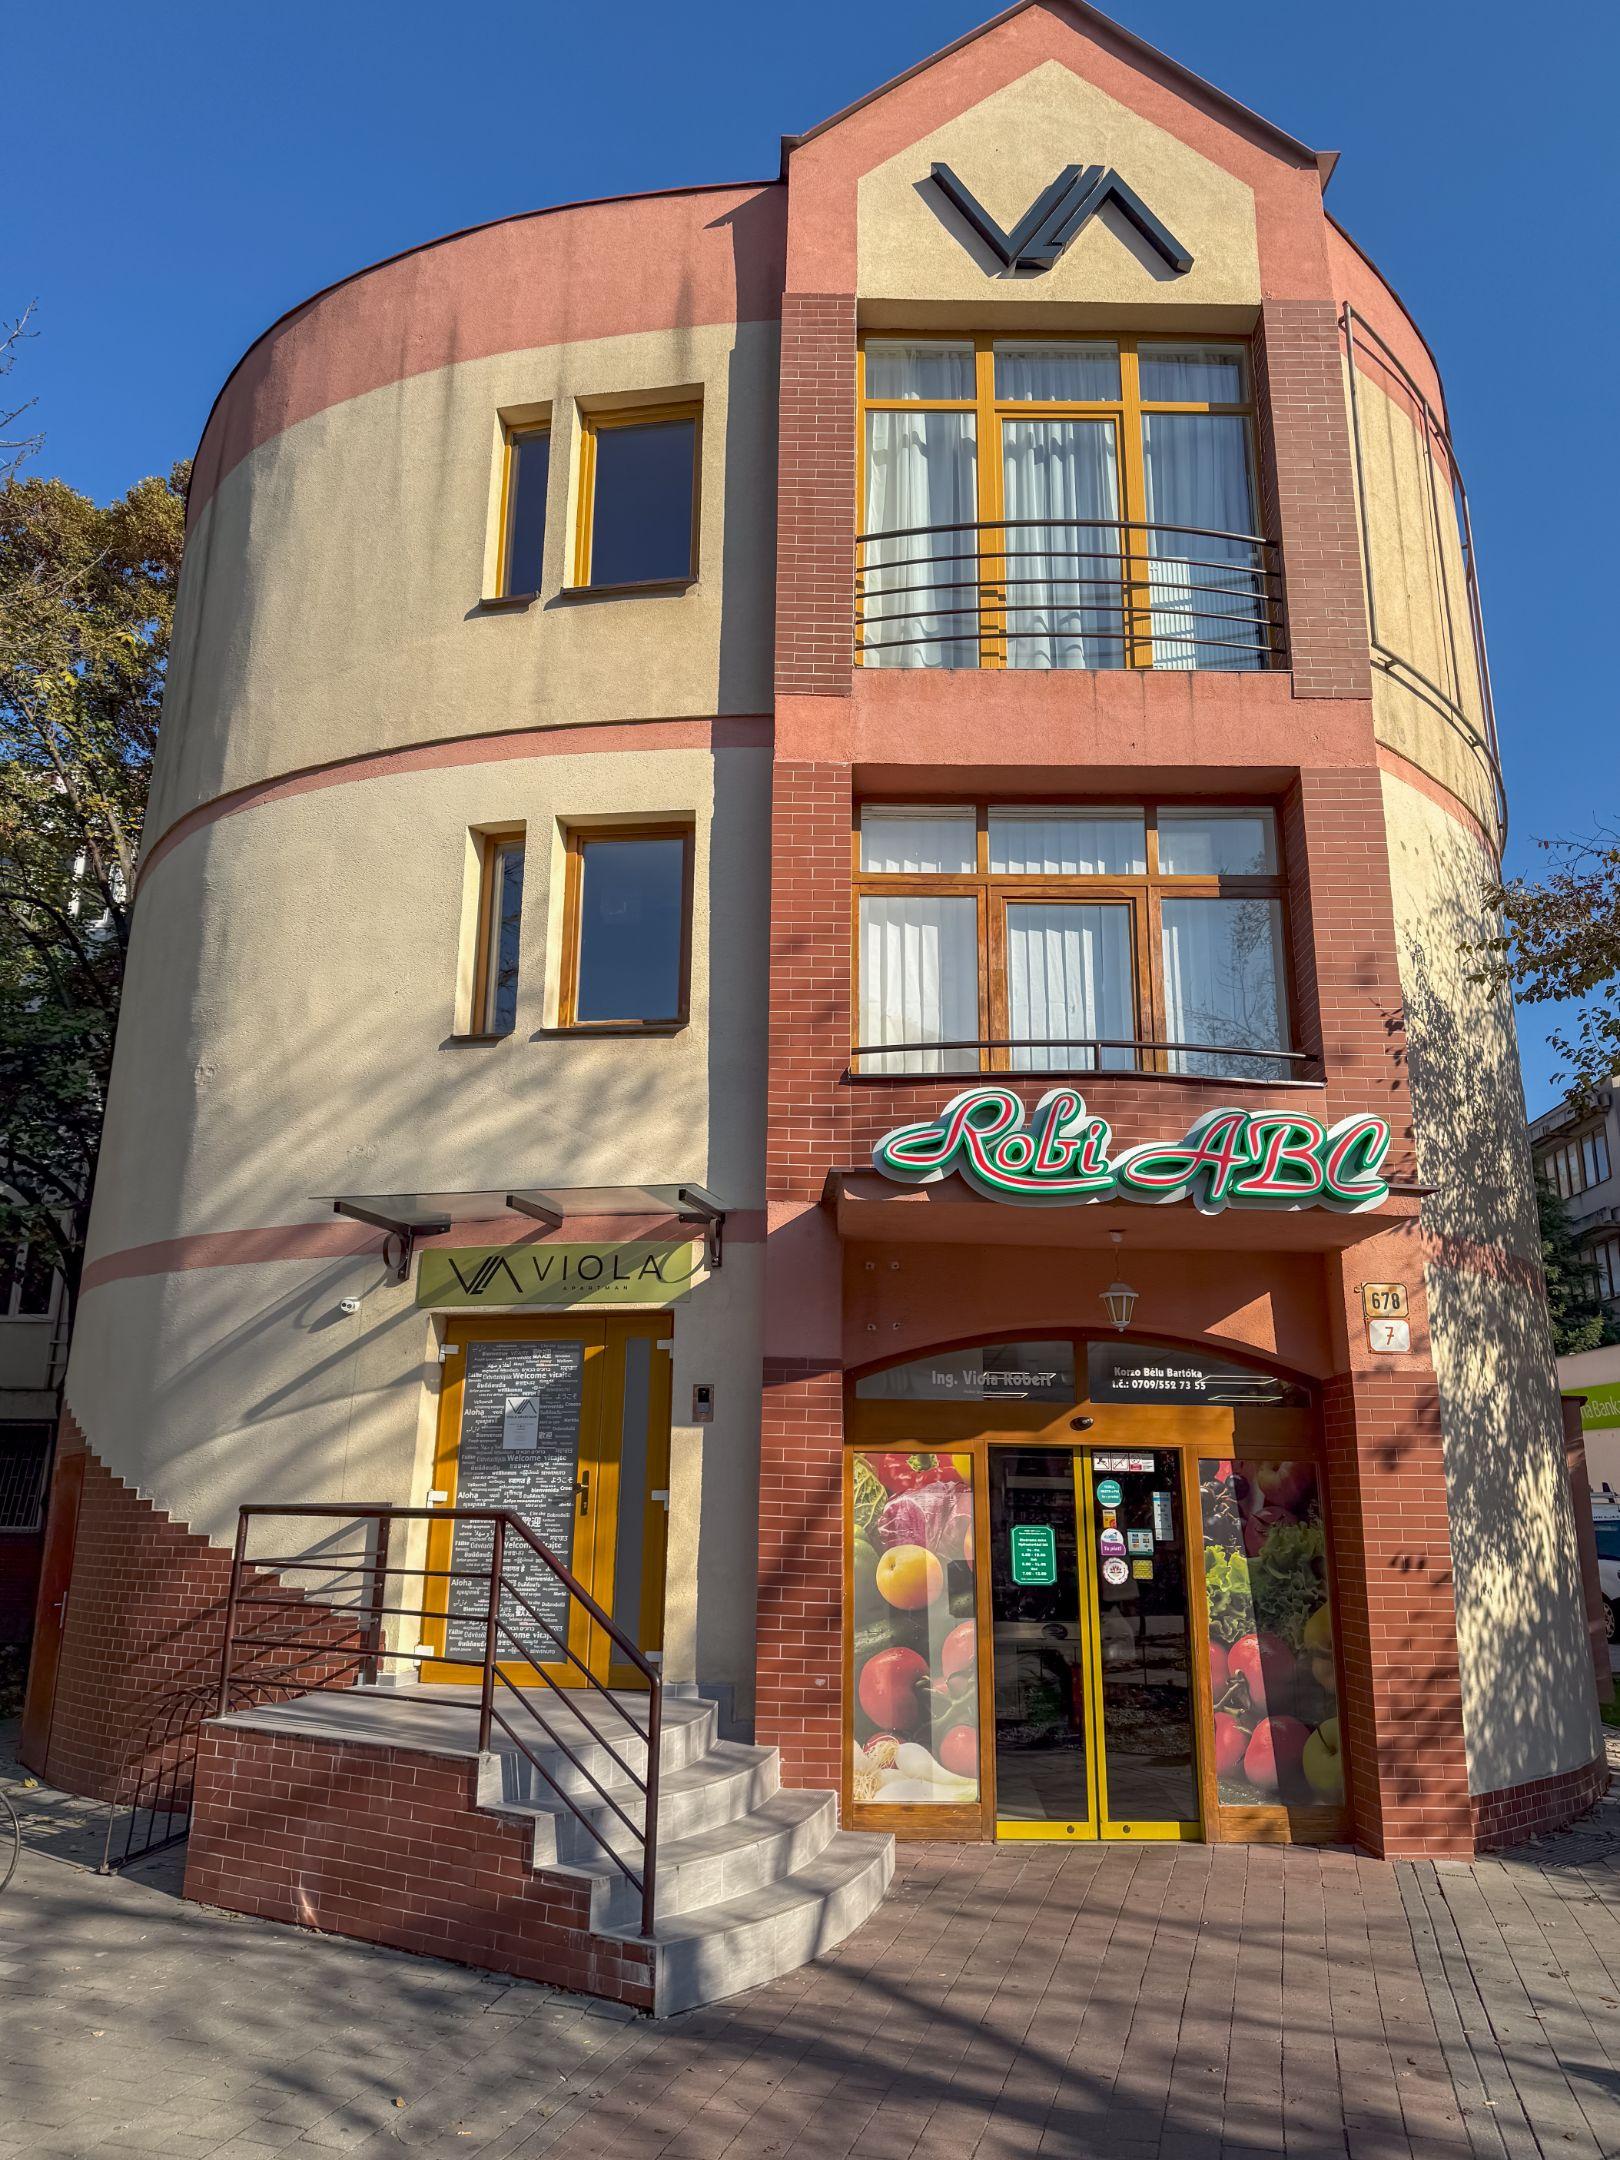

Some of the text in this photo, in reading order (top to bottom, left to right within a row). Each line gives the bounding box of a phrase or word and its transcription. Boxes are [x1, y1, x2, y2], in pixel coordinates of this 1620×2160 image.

[882, 1088, 1391, 1203] Robi ABC
[532, 1253, 663, 1283] VIOLA
[1371, 1291, 1400, 1310] 678
[1384, 1326, 1395, 1346] 7
[931, 1370, 1052, 1388] Ing. Viola Robert
[1113, 1366, 1141, 1377] Korzo
[1166, 1367, 1203, 1378] Bartóka
[1131, 1379, 1177, 1390] 0709/552
[1179, 1380, 1191, 1390] 73
[1194, 1381, 1207, 1391] 55
[457, 1491, 479, 1499] Aloha
[451, 1578, 473, 1586] Aloha
